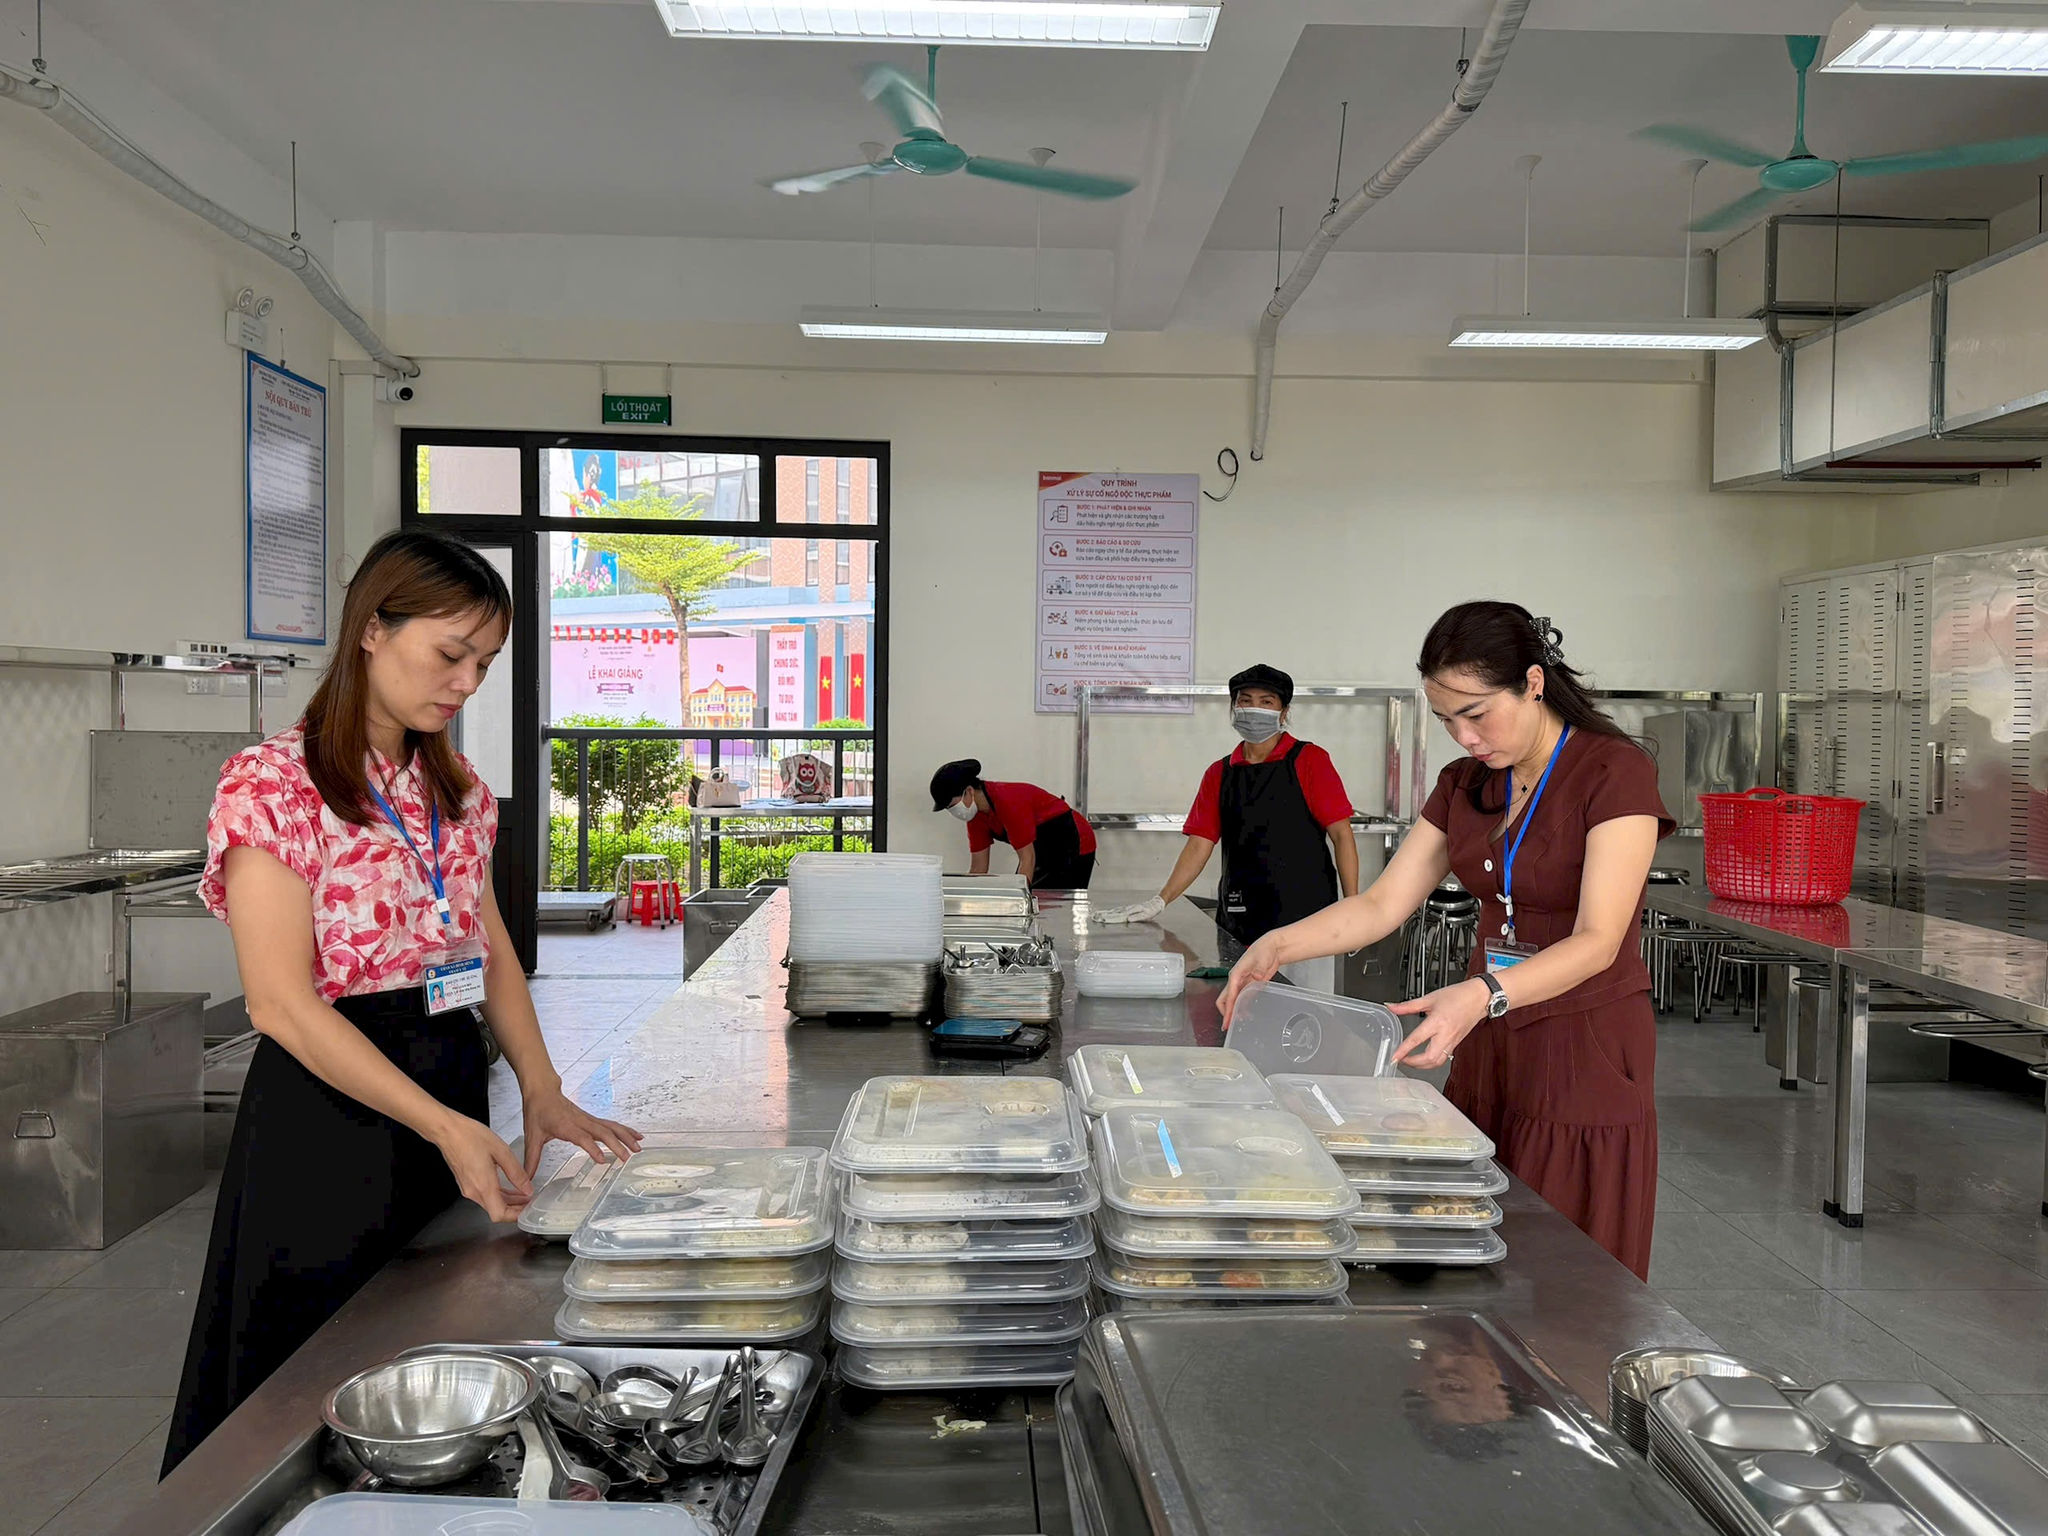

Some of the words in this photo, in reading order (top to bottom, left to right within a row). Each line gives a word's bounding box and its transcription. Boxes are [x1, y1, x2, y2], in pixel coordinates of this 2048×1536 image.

[629, 401, 662, 412] THOÁT
[1117, 478, 1137, 487] TRÌNH
[1105, 490, 1119, 498] NGỘ
[1134, 490, 1152, 499] THỰC
[1153, 489, 1172, 498] PHẨM
[598, 668, 616, 679] KHAI
[617, 665, 643, 680] GIẢNG
